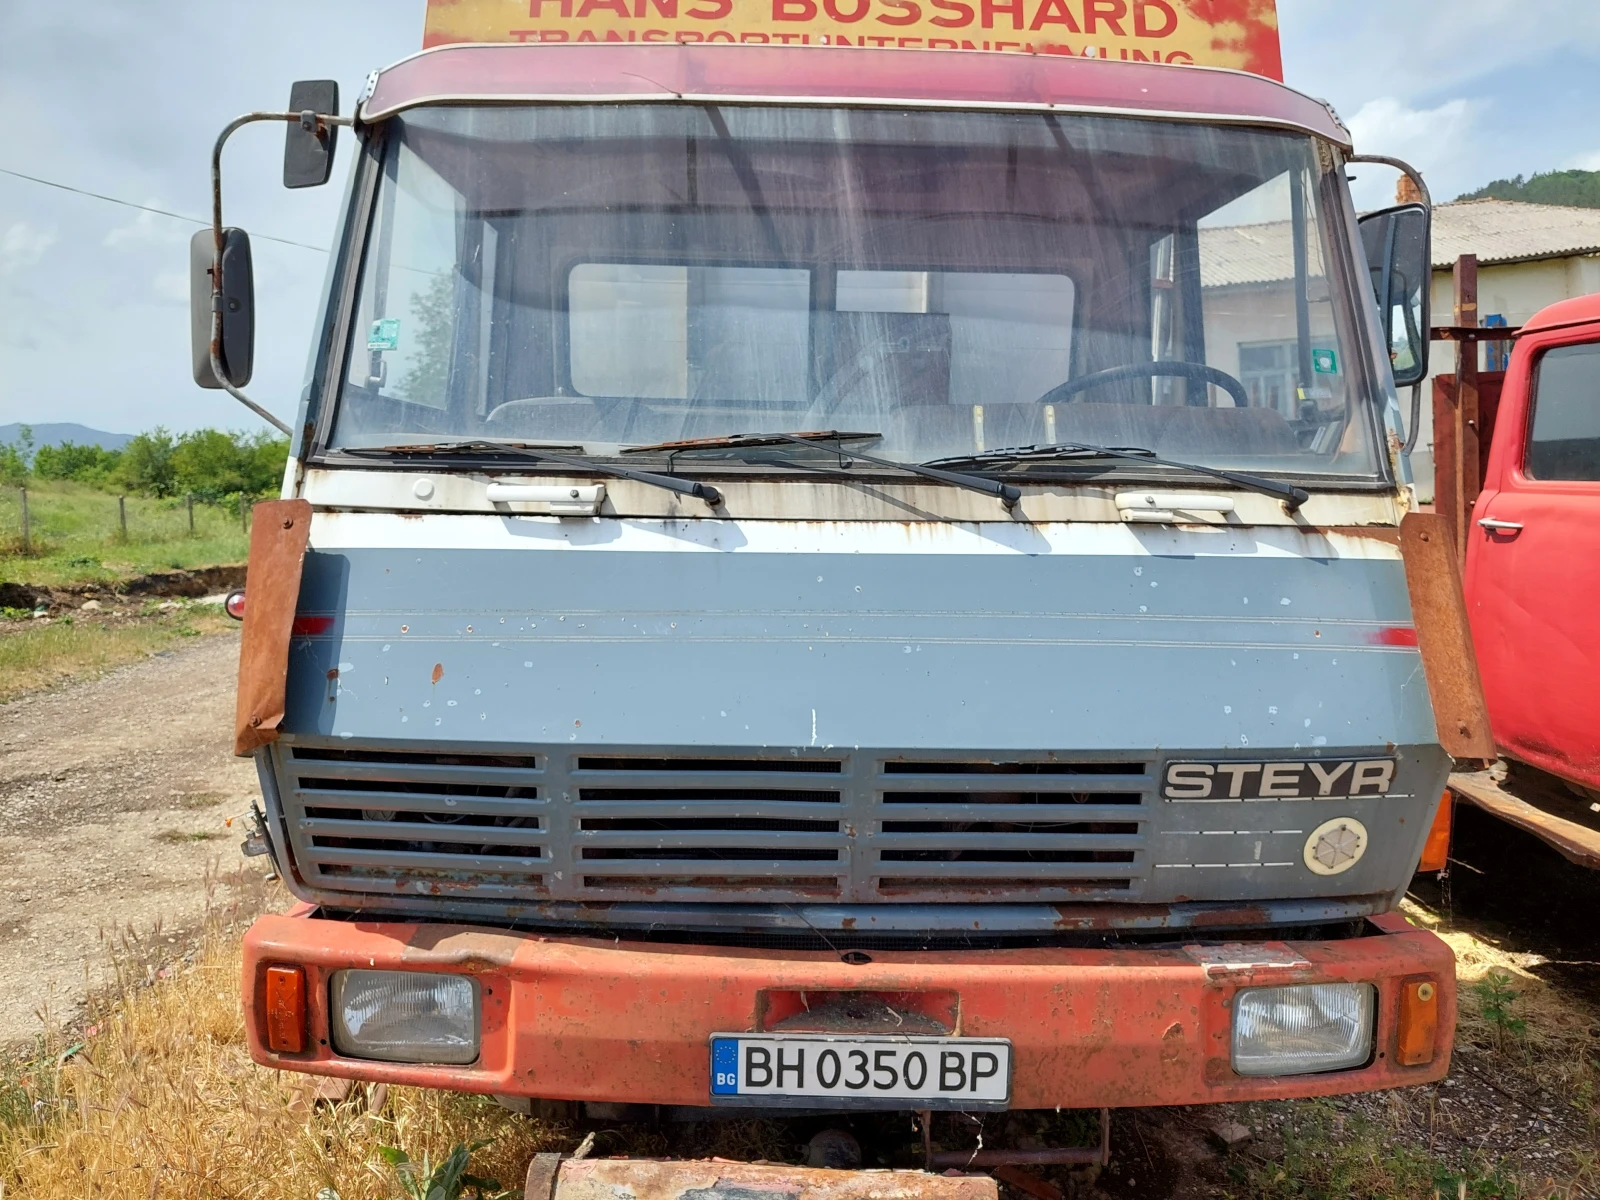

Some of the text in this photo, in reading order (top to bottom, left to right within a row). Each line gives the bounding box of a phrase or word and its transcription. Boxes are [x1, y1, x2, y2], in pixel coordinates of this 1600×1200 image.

[772, 0, 1178, 38] BOSSHARD
[1165, 760, 1395, 798] STEYR
[716, 1072, 736, 1086] BG
[745, 1046, 999, 1092] BH 0350 BP
